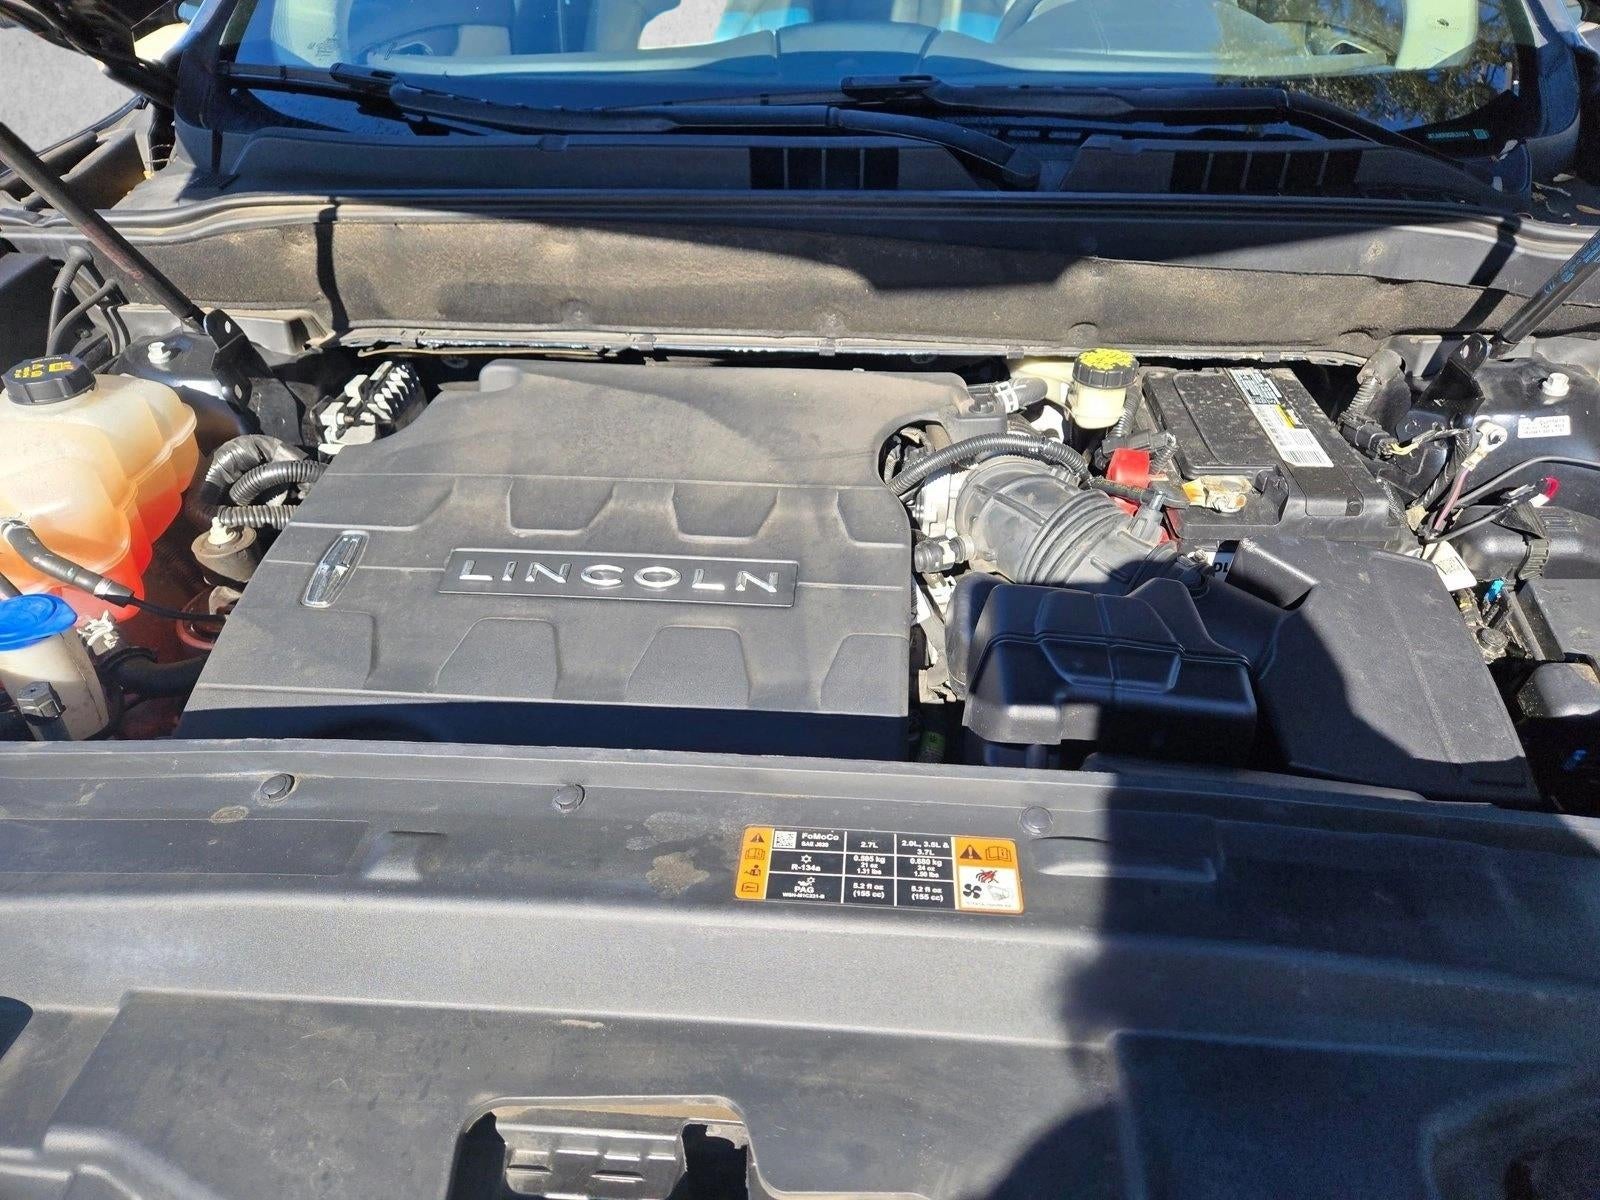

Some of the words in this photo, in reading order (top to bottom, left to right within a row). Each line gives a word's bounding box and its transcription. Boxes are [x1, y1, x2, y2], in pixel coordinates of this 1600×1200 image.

[459, 559, 779, 593] LINCOLN
[801, 832, 840, 841] FoMoCo
[860, 841, 879, 849] 2.7L
[917, 848, 936, 856] 3.7L
[875, 855, 886, 864] kg
[932, 859, 943, 868] kg
[791, 863, 821, 872] R-134a
[794, 885, 815, 893] PAG
[911, 885, 924, 893] 5.2
[852, 889, 871, 898] (155
[871, 890, 885, 899] cc)
[911, 892, 929, 901] (155
[930, 894, 944, 903] cc)
